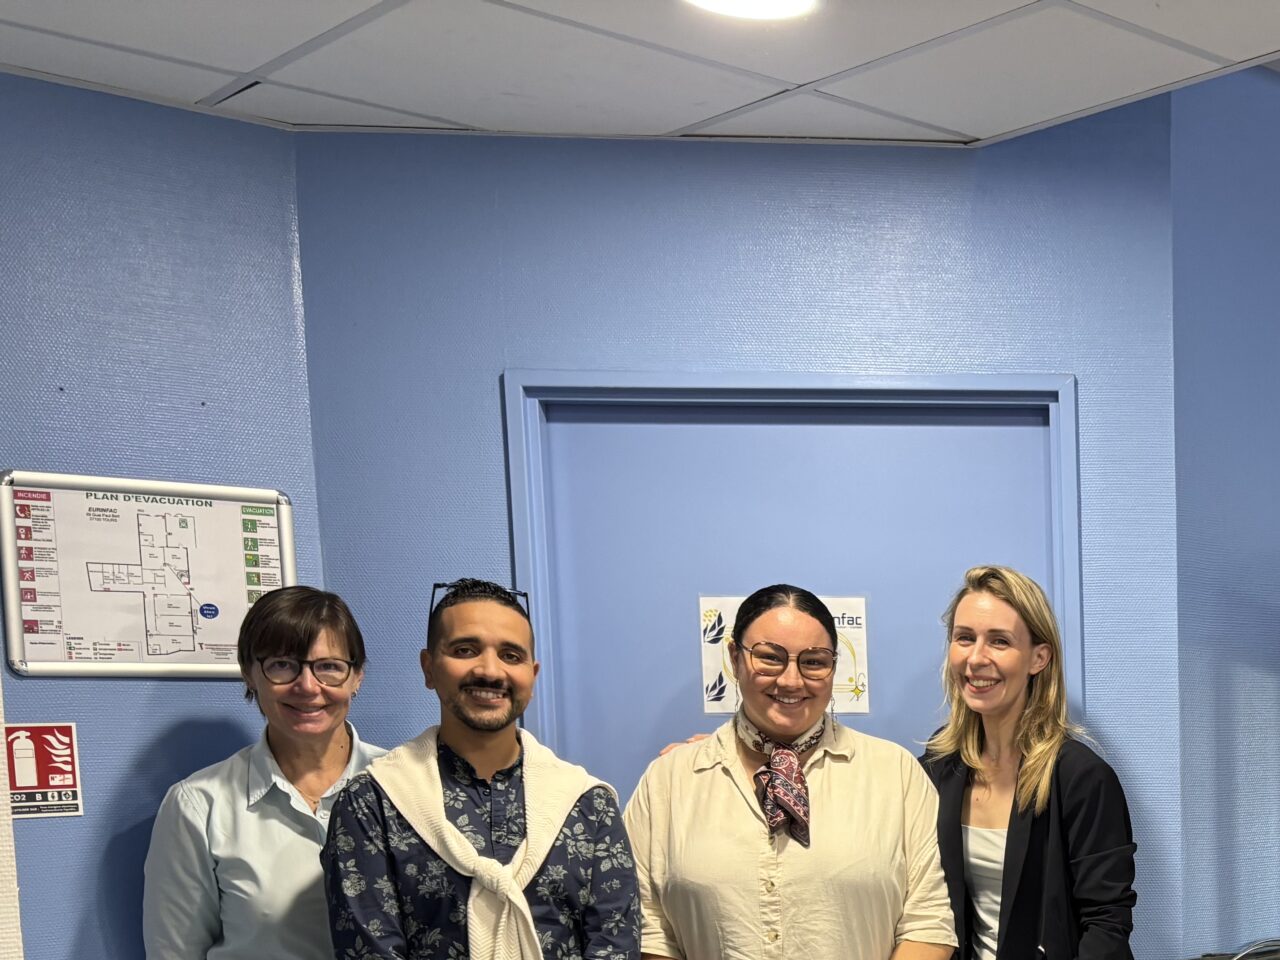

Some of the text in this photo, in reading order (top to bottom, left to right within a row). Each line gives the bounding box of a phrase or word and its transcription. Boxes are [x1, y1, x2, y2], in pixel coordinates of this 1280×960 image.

[85, 492, 213, 507] PLAN D'EVACUATION
[832, 612, 862, 626] nfac
[35, 793, 42, 801] B
